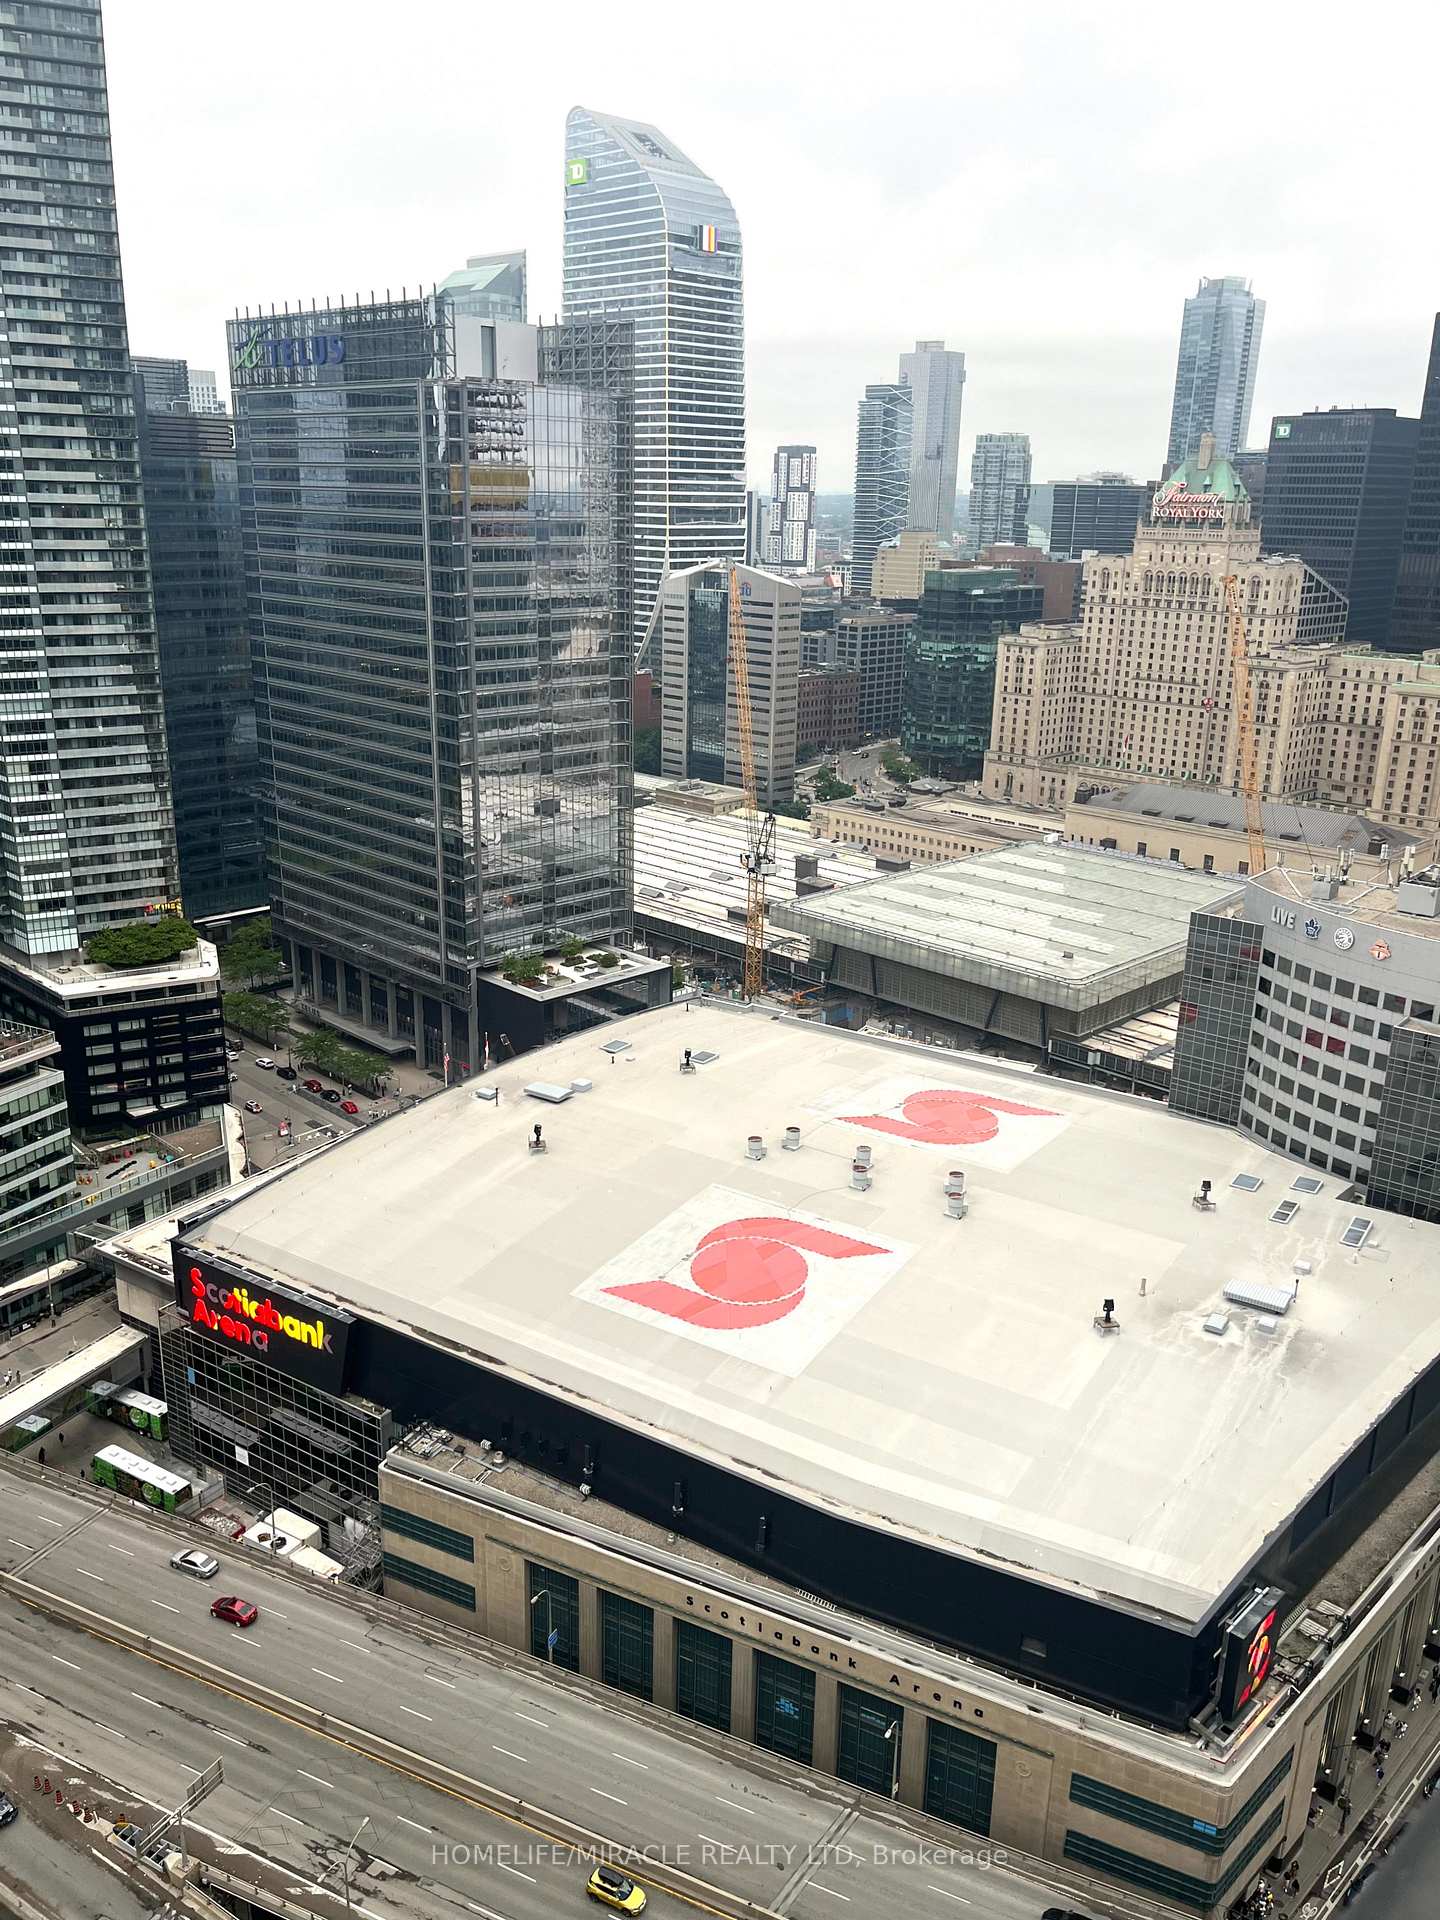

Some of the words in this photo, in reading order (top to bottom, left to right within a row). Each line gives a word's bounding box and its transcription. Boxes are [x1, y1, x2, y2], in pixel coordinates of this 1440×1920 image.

[264, 335, 345, 369] TELUS
[1152, 481, 1226, 507] Fairmont
[1152, 506, 1189, 519] ROYAL
[1191, 506, 1225, 519] YORK
[1271, 905, 1296, 929] LIVE
[190, 1267, 335, 1354] Scotiabank
[193, 1298, 269, 1352] Arena
[889, 1674, 984, 1718] Arena
